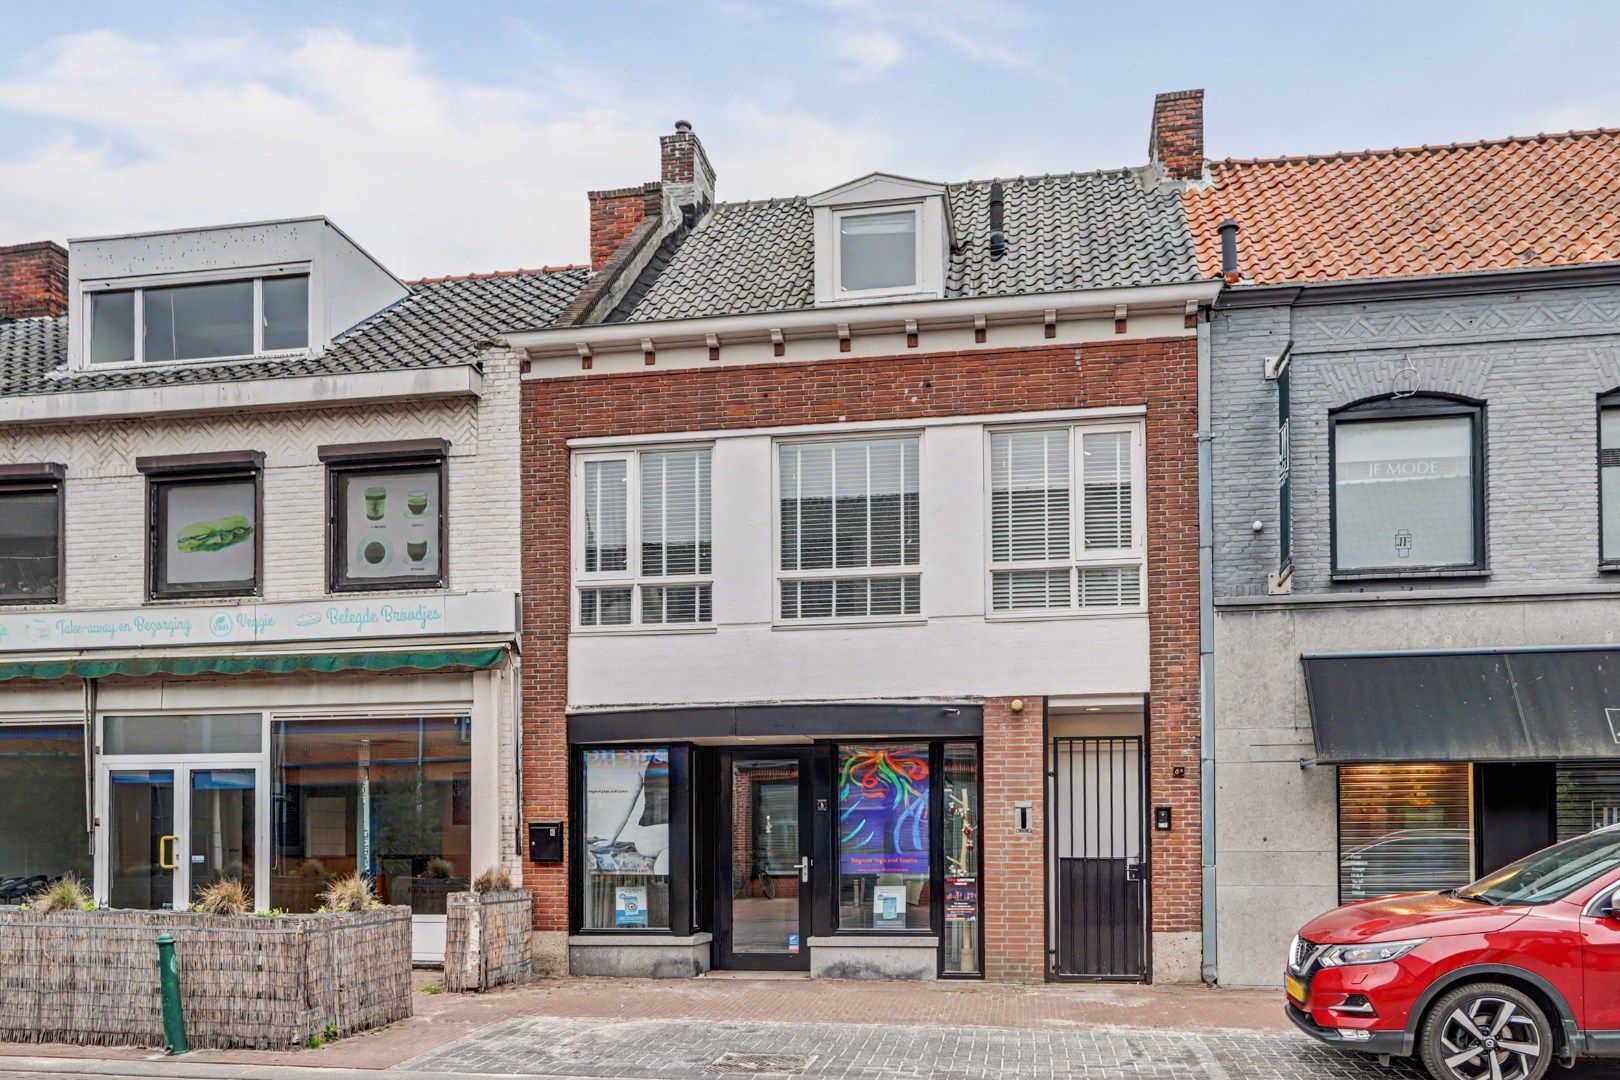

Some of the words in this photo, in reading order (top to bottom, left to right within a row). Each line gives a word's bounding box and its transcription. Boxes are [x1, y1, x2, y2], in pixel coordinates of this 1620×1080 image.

[1387, 461, 1438, 475] MODE
[56, 618, 116, 641] Take-away
[118, 623, 132, 633] en
[133, 615, 192, 638] Bezorging
[236, 612, 276, 633] Veggie
[326, 606, 378, 632] Belegde
[380, 604, 442, 629] Broodjes
